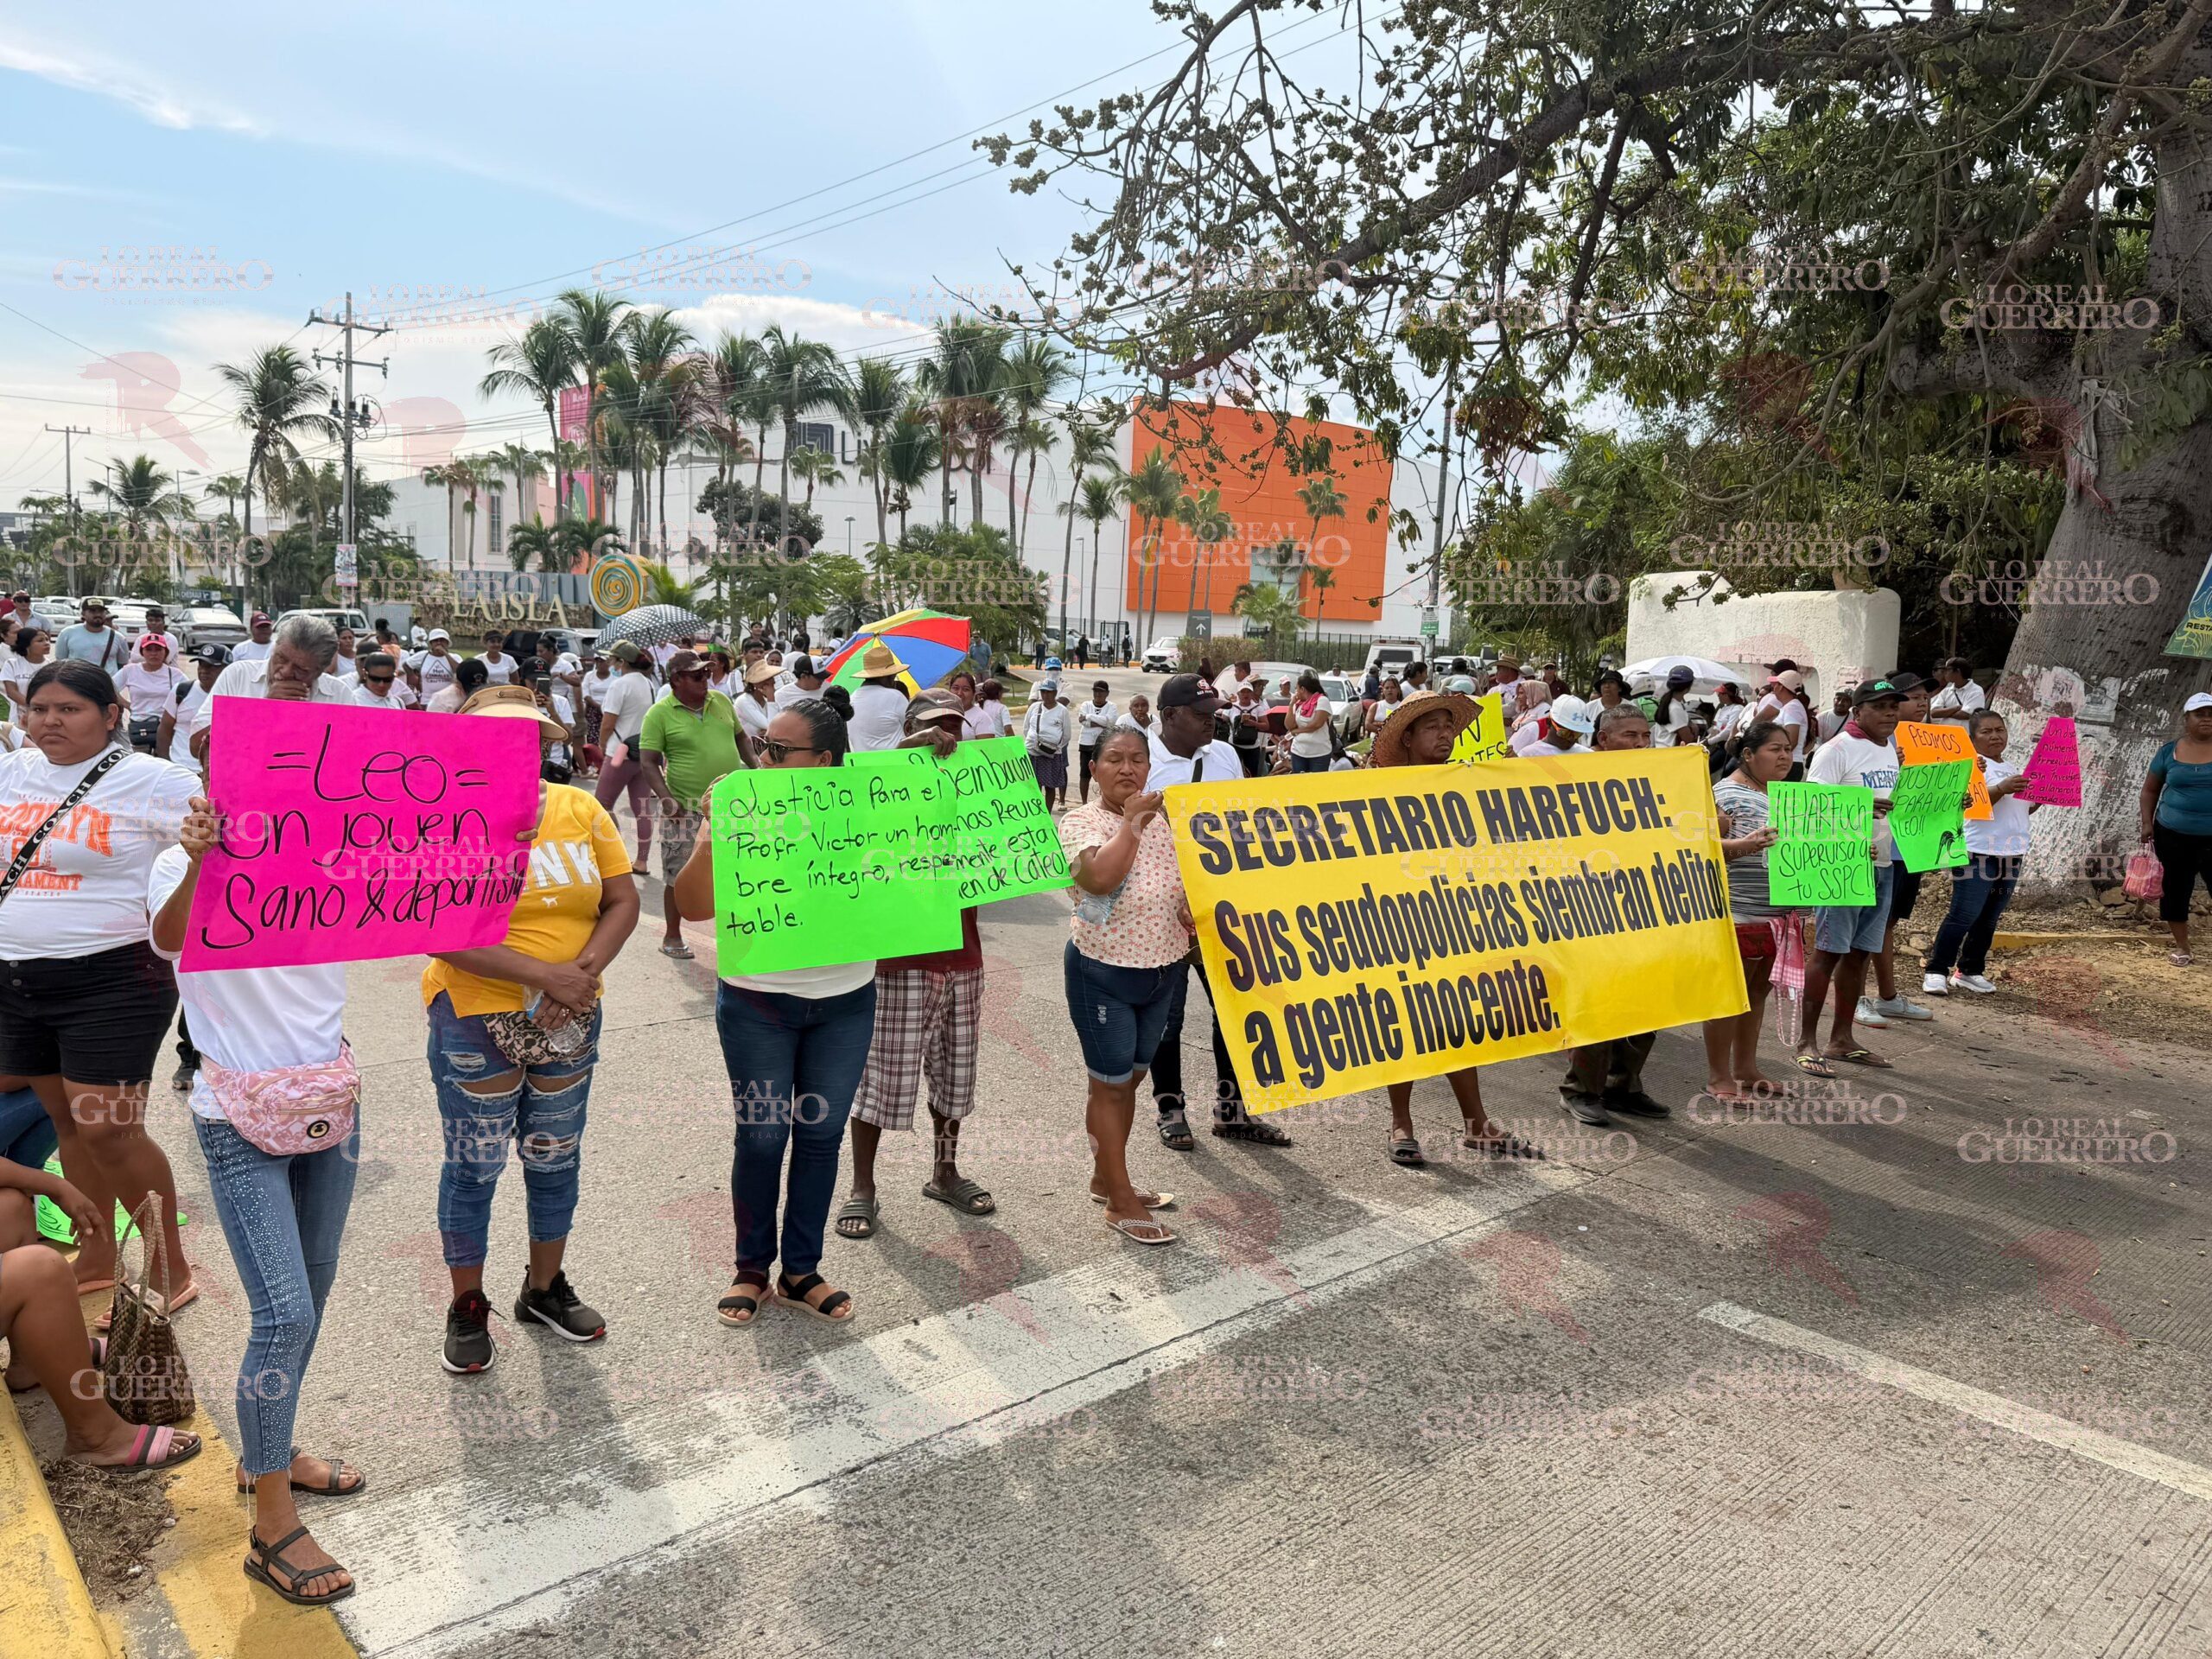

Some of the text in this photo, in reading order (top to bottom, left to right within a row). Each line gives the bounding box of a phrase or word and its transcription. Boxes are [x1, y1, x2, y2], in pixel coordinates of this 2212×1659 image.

[454, 589, 569, 628] LA ISLA
[1908, 724, 1961, 754] PEDIMOS
[729, 774, 855, 823] Justicia
[921, 779, 943, 801] el
[1893, 791, 1933, 814] PARA
[1189, 777, 1674, 876] SECRETARIO HARFUCH:
[735, 871, 792, 898] bre
[727, 903, 804, 938] table.
[1214, 899, 1302, 993] Sus
[1295, 871, 1529, 977] seudopolicias
[1519, 859, 1659, 944] siembran
[1243, 958, 1561, 1090] a gente inocente.
